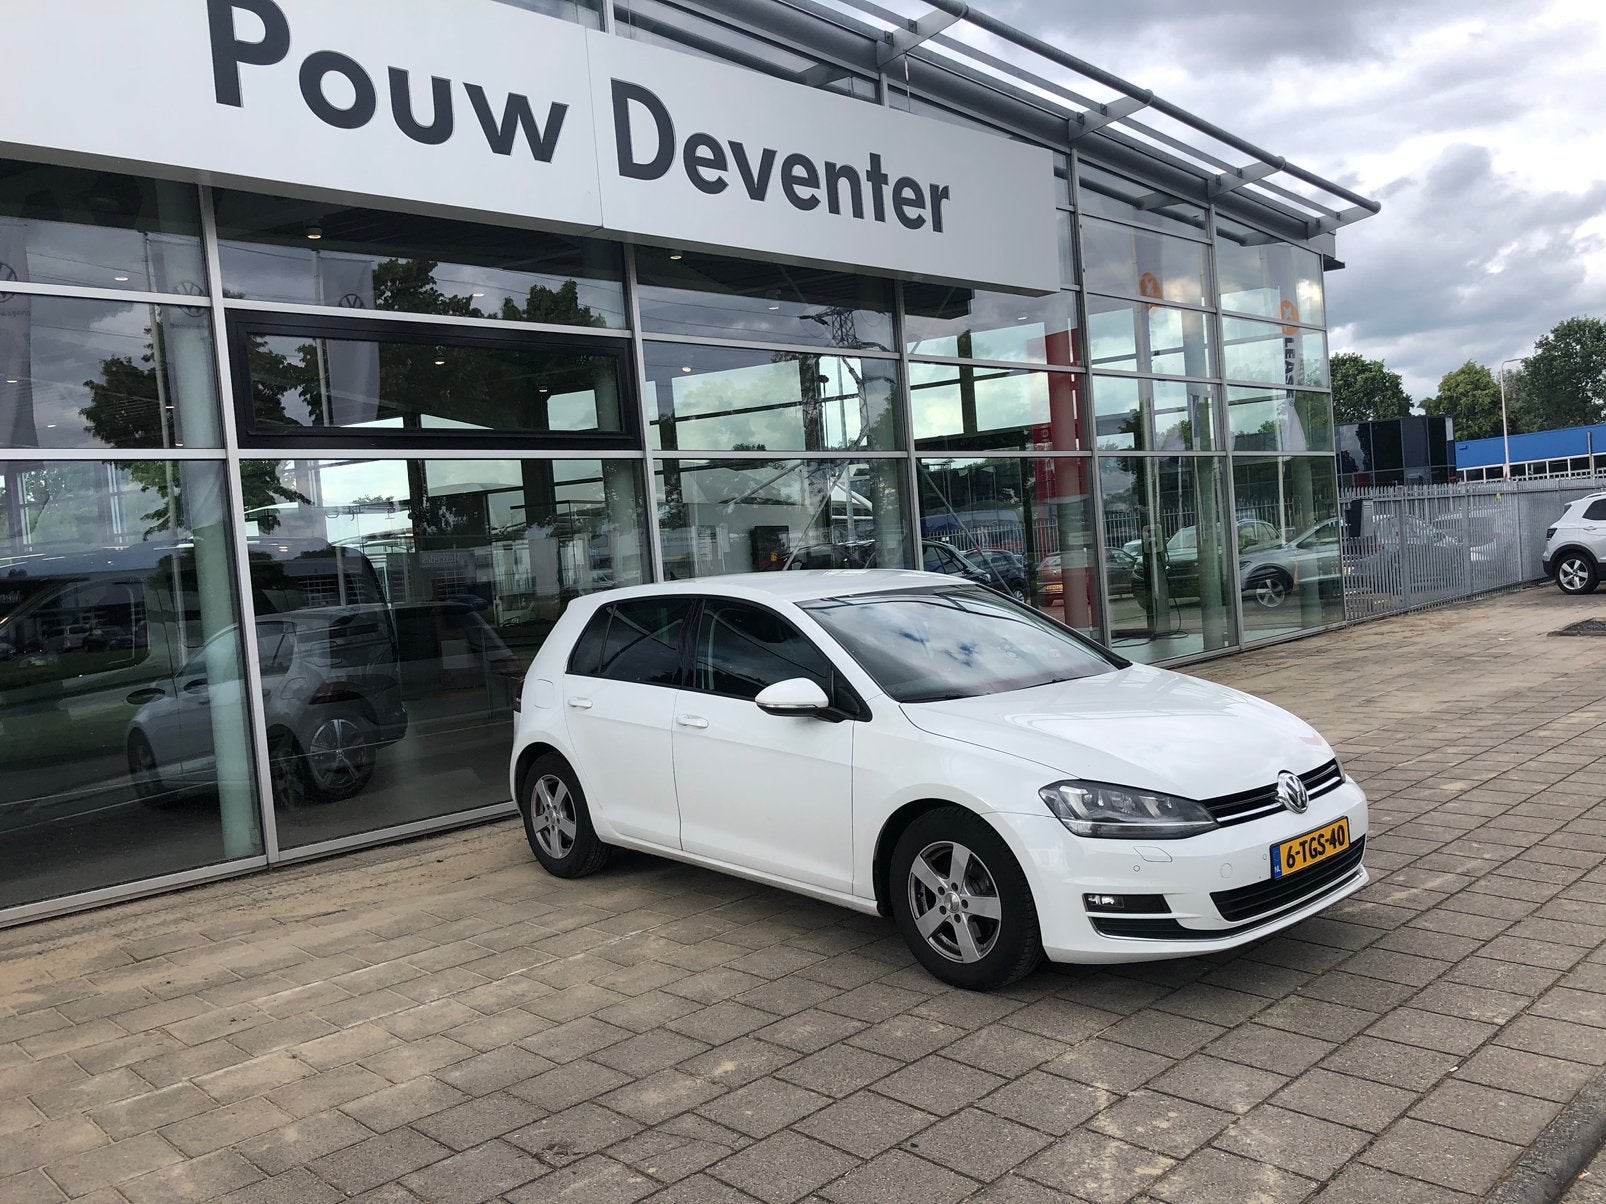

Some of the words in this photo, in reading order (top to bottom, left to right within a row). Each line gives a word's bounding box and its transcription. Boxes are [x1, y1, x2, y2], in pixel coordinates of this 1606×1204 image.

[206, 0, 570, 163] Pouw
[610, 78, 951, 234] Deventer
[1285, 824, 1346, 869] 6-TGS-40
